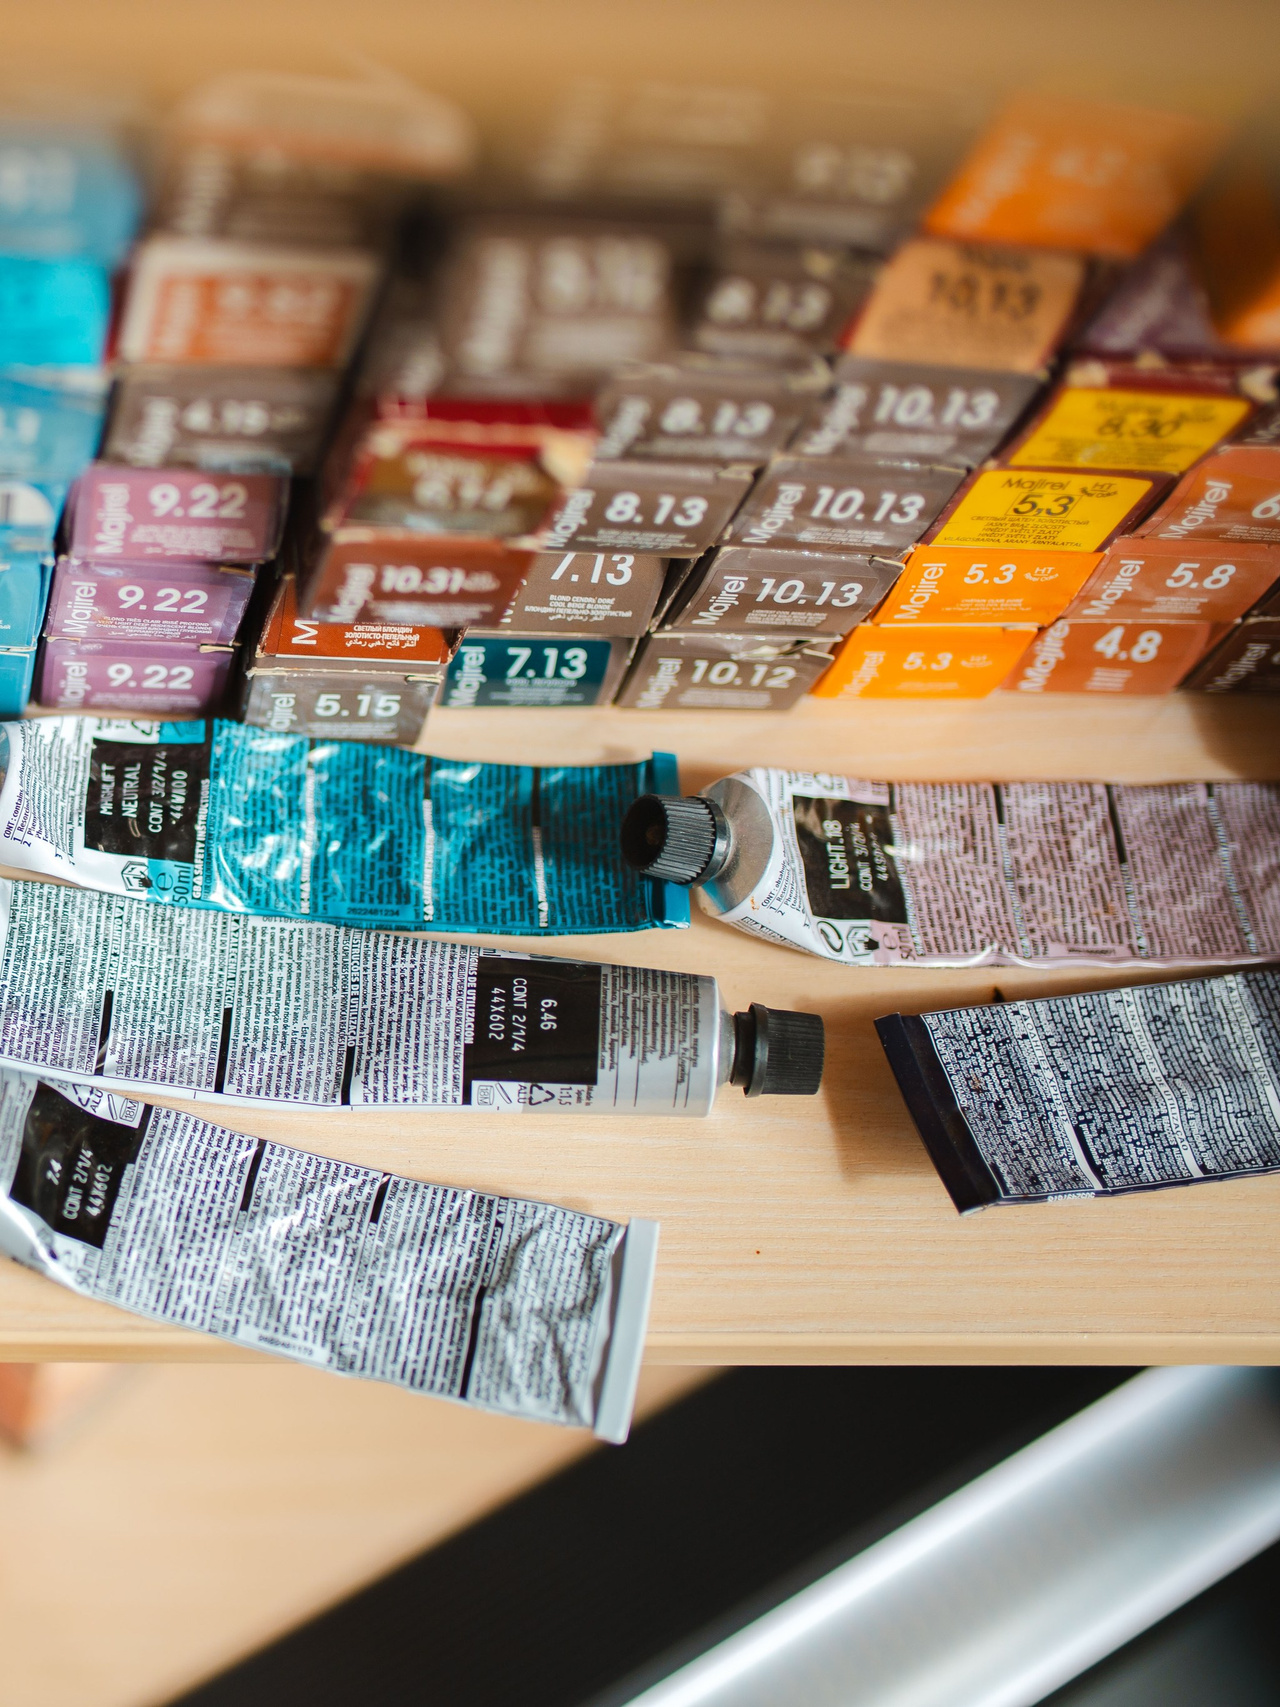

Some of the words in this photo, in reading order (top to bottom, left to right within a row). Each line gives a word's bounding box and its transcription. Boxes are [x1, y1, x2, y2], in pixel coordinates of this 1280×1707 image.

[876, 386, 999, 428] 10.13
[149, 483, 248, 520] 9.22
[1002, 478, 1072, 492] Majirel
[96, 483, 134, 555] Majirel
[545, 489, 595, 549] Majirel
[605, 491, 708, 528] 8.13
[743, 483, 806, 544] Majirel
[809, 486, 925, 524] 10.13
[1012, 494, 1074, 517] 5,3
[1158, 481, 1233, 539] Majirel
[382, 564, 466, 594] 10.31
[964, 563, 1016, 585] 5.3
[1034, 566, 1056, 575] HT
[1083, 559, 1145, 616] Majirel
[1165, 563, 1237, 589] 5.8
[62, 581, 98, 634] Majirel
[117, 585, 208, 614] 9.22
[586, 603, 612, 611] BLONDE
[597, 597, 616, 605] DORÉ
[692, 575, 748, 626] Majirel
[756, 578, 864, 608] 10.13
[894, 563, 947, 620] Majirel
[344, 631, 420, 642] ЗОЛОТИСТО-ПЕПЕЛЬНЫЙ
[354, 624, 381, 633] СВЕТЛЫЙ
[382, 625, 413, 634] БЛОНДИН
[1094, 625, 1163, 663] 4.8
[107, 663, 195, 690] 9.22
[449, 646, 487, 707] Majirel
[507, 647, 587, 680] 7.13
[690, 659, 797, 690] 10.12
[902, 652, 954, 672] 5.3
[636, 657, 683, 710] Majirel
[314, 693, 402, 718] 5.15
[122, 761, 140, 817] NEUTRAL
[148, 801, 164, 833] CONT
[196, 778, 210, 841] INSTRUCTIONS
[3, 821, 14, 838] CONT
[195, 841, 205, 875] SAFETY
[822, 817, 850, 890] LIGHT.18
[174, 864, 191, 884] ml
[857, 859, 874, 891] CONT
[172, 885, 189, 904] 50
[193, 884, 201, 898] GB
[345, 906, 400, 918] 2622481234
[350, 983, 358, 995] DE
[467, 976, 476, 987] DE
[511, 977, 526, 1008] CONT
[346, 998, 358, 1047] UTILIZAÇÃO
[464, 989, 476, 1044] UTILIZACIÓN
[489, 987, 505, 1040] 44X602
[539, 998, 557, 1031] 6.46
[510, 1014, 525, 1052] 2/1/4
[1024, 1023, 1050, 1074] ΟΔΗΓΙΕΣ
[1045, 1076, 1071, 1125] ΧΡΗΣΗΣ
[1127, 1009, 1158, 1073] INSTRUÇÕES
[1160, 1089, 1189, 1151] UTILIZAÇÃO
[89, 1090, 103, 1113] ALU
[124, 1099, 138, 1117] 18M
[516, 1084, 526, 1104] ALU
[558, 1085, 571, 1106] 1:1,5
[72, 1148, 94, 1183] 2/1/4
[62, 1185, 84, 1220] CONT
[84, 1162, 113, 1217] 44X602
